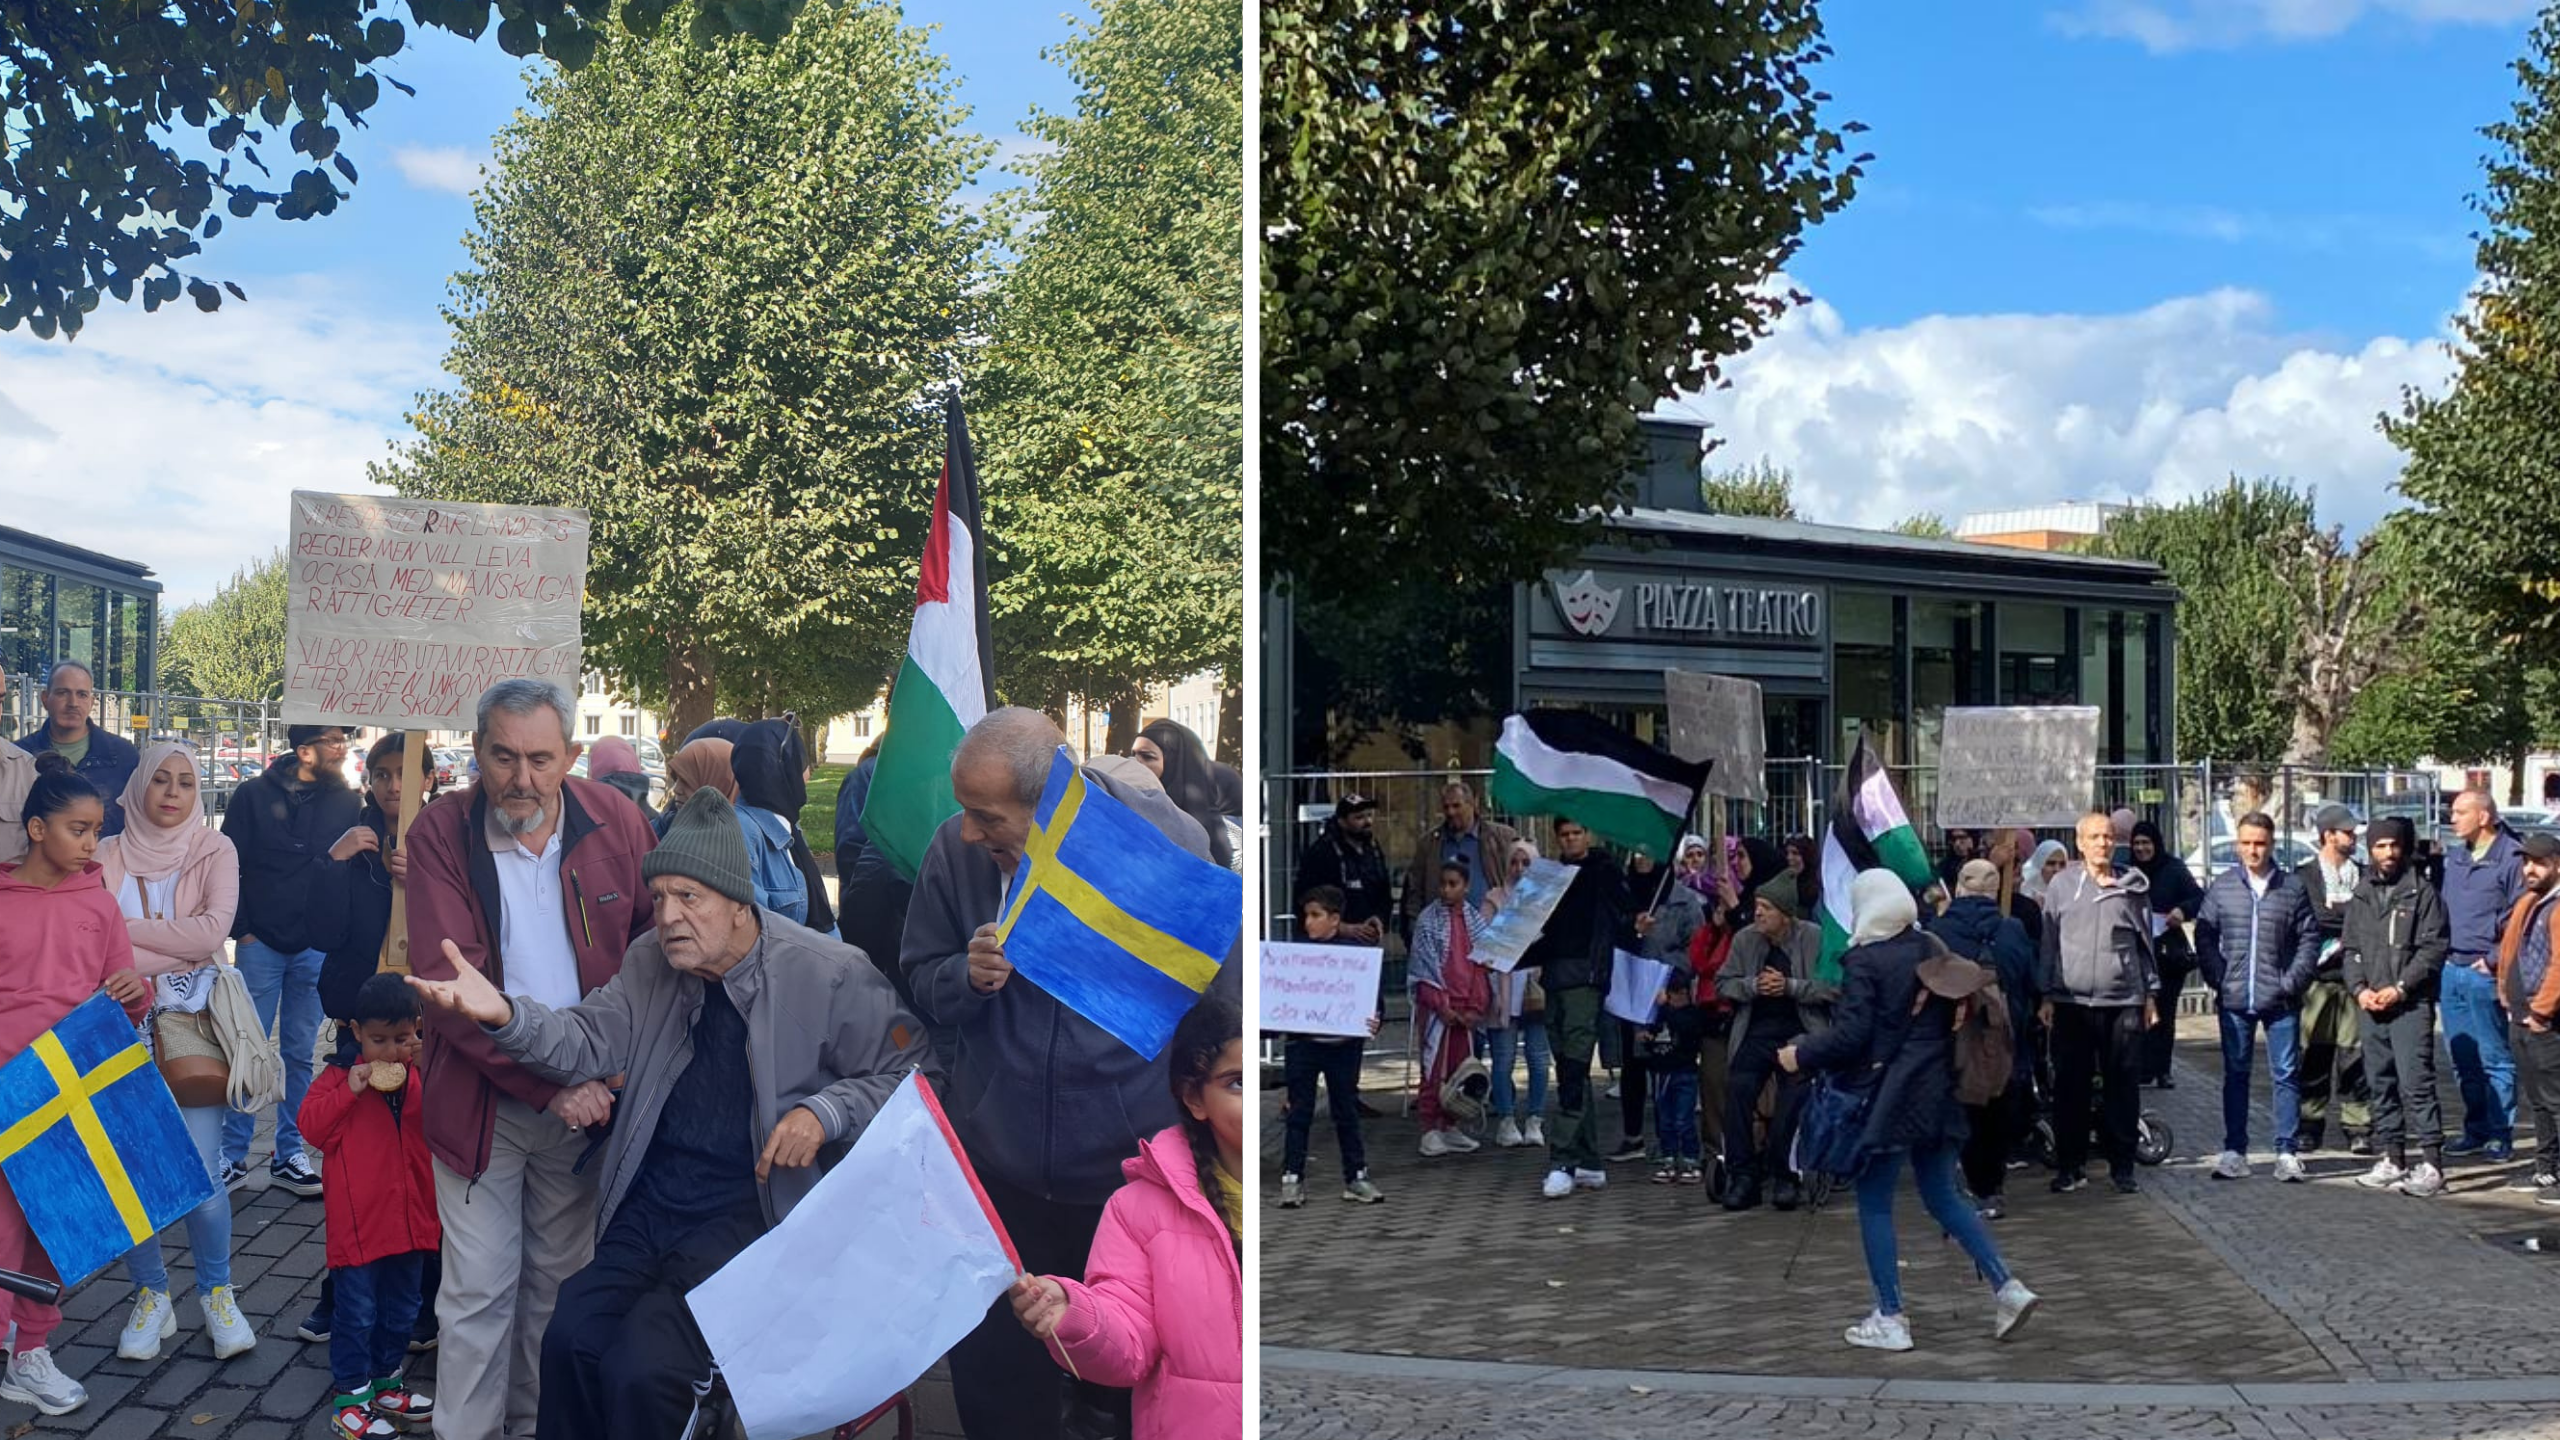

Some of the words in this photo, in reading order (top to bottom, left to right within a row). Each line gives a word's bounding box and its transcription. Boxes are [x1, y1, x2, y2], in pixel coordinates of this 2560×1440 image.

[299, 503, 320, 525] VI
[470, 512, 571, 542] LANDETS
[297, 532, 373, 559] REGLER
[373, 541, 421, 563] MEN
[424, 543, 466, 564] VILL
[475, 545, 531, 569] LEVA
[301, 561, 378, 589] OCKSÅ
[390, 568, 434, 594] MED
[442, 569, 576, 603] MÄNSKLIGA
[306, 587, 474, 623] RÄTTIGHETER
[1636, 583, 1720, 630] PIAZZA
[1724, 588, 1820, 635] TEATRO
[298, 637, 322, 665] VI
[326, 638, 368, 669] BOR
[371, 638, 409, 671] HÄR
[415, 643, 471, 672] UTAN
[291, 664, 348, 691] ETER
[355, 670, 420, 696] INGEN
[428, 672, 526, 699] INKOM
[319, 689, 387, 715] INGEN
[400, 694, 460, 718] SKOLA
